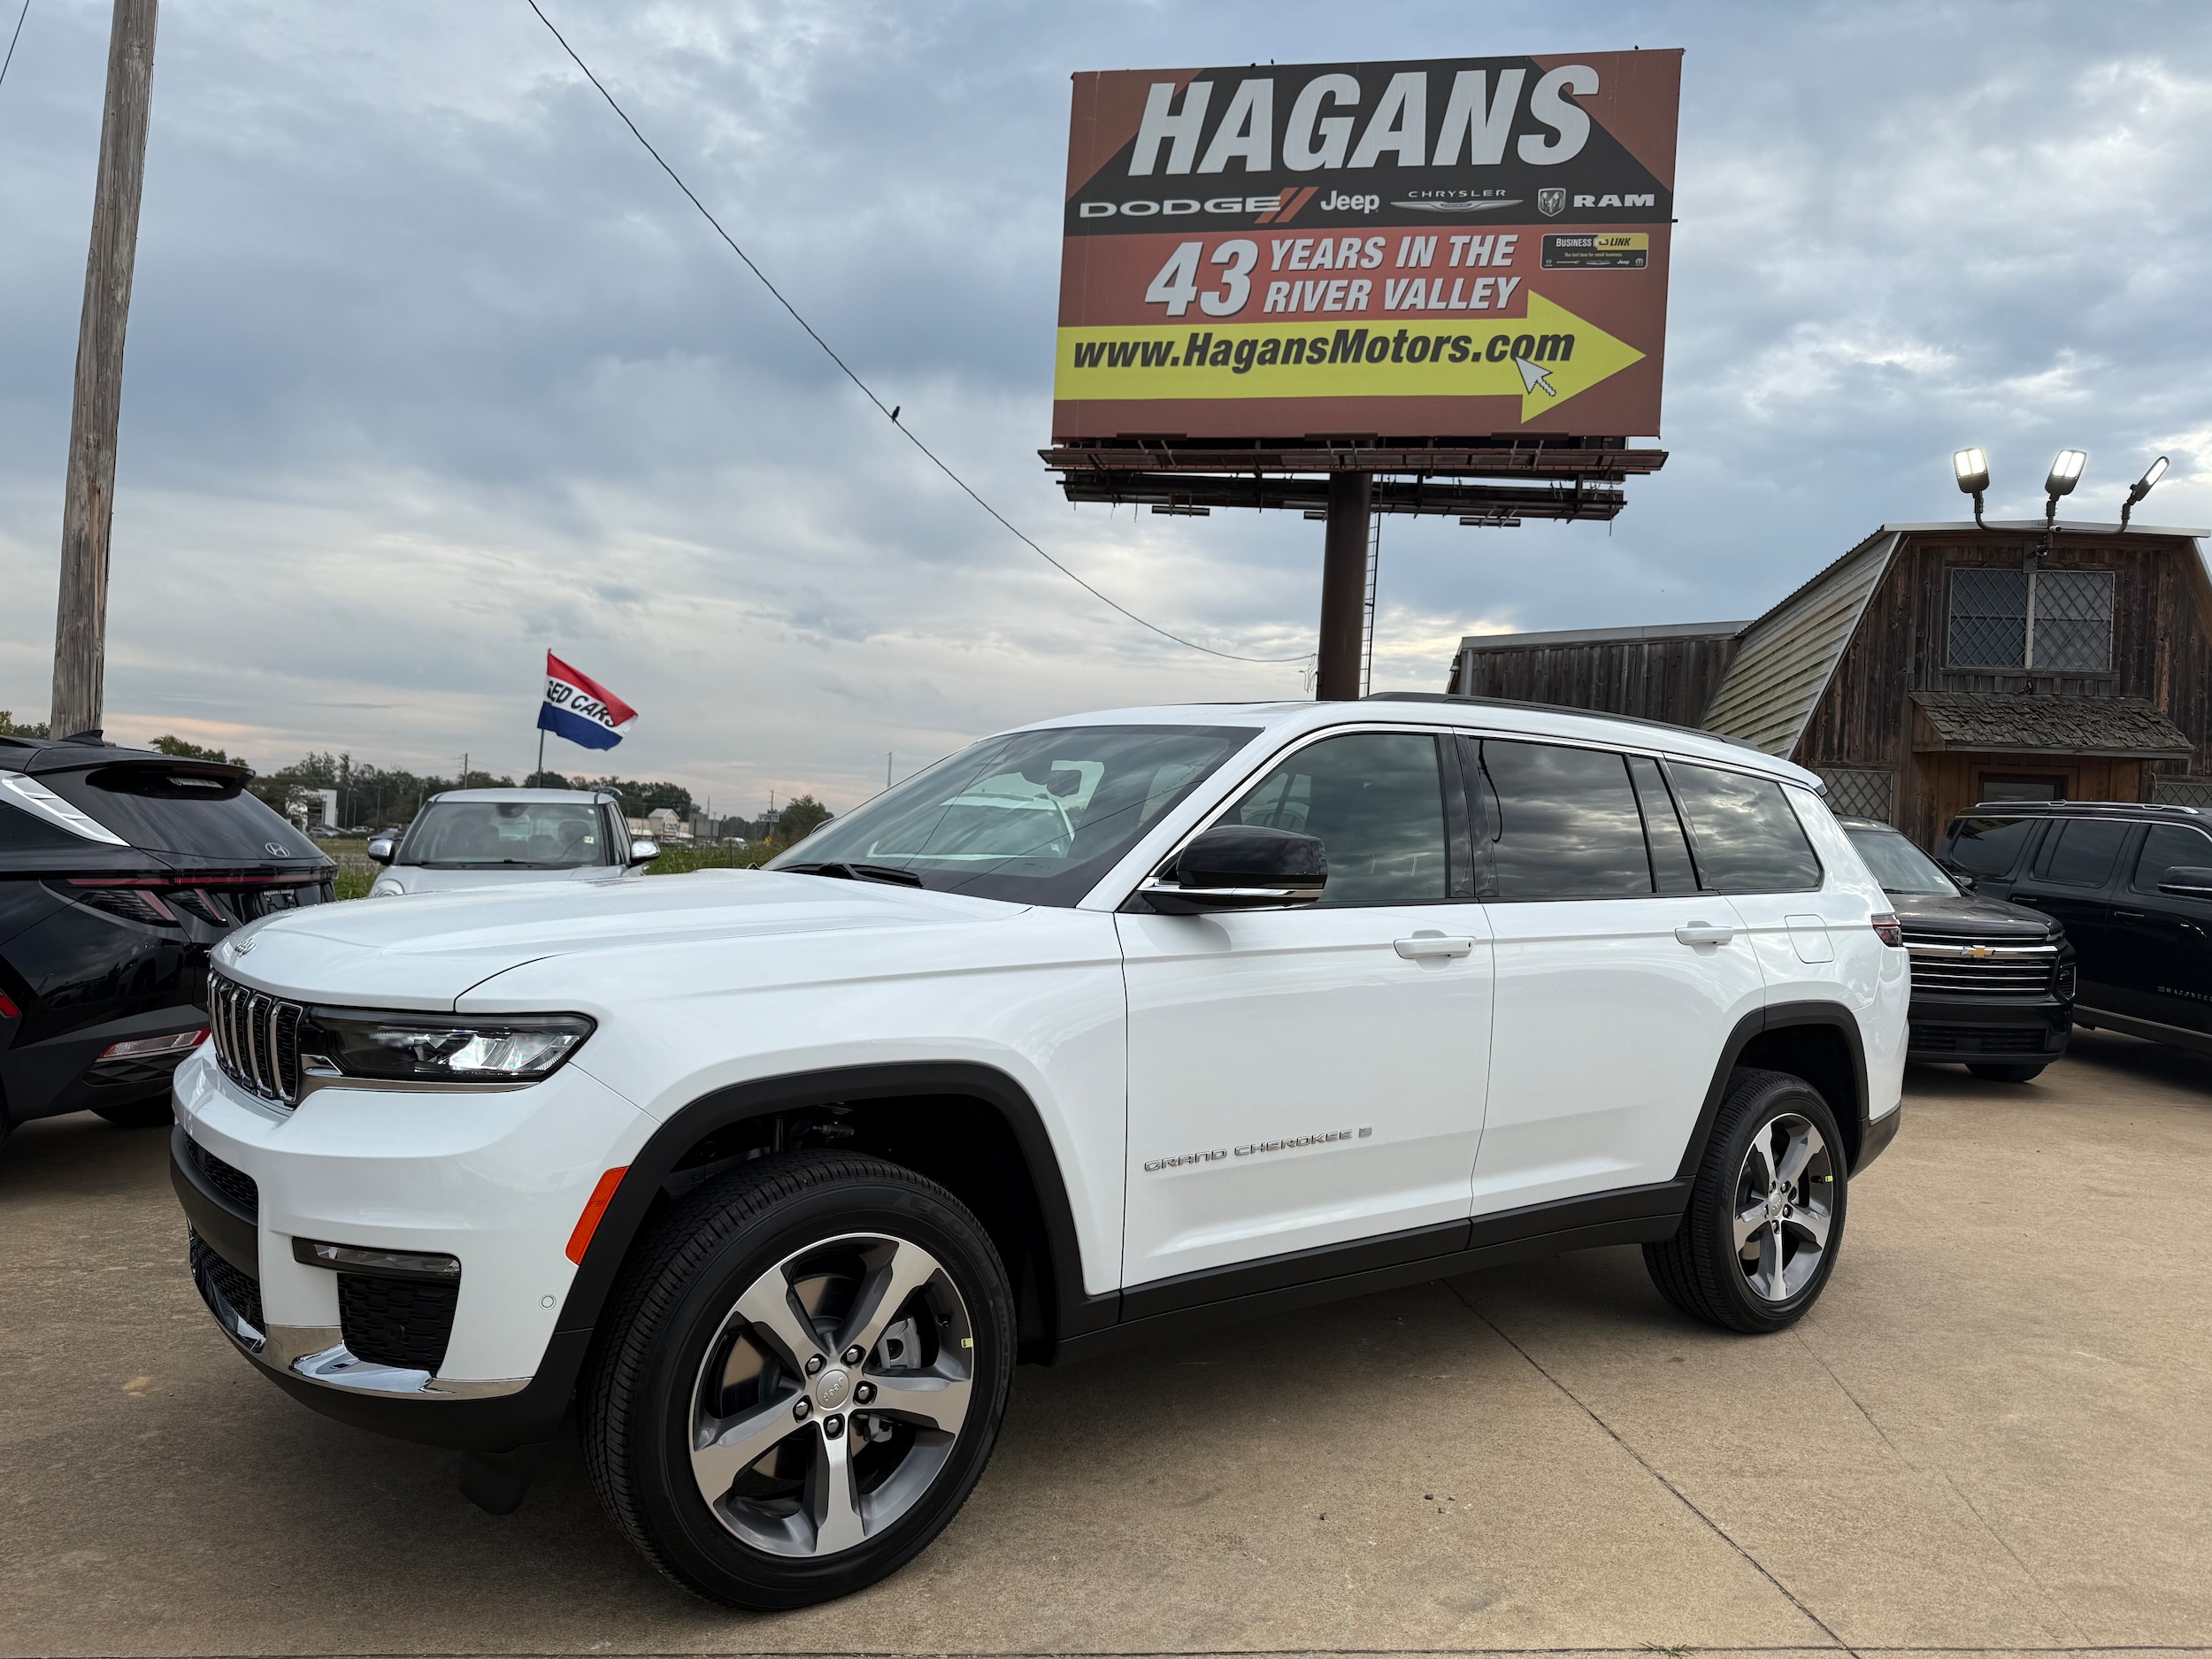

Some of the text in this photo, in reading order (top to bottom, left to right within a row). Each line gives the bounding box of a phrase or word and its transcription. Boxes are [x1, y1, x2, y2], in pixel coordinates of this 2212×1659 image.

[1127, 65, 1600, 176] HAGANS
[1079, 196, 1281, 218] DODGE
[1320, 190, 1379, 213] Jeep
[1408, 189, 1506, 198] CHRYSLER
[1573, 194, 1655, 207] RAM
[1270, 234, 1519, 271] YEARS IN THE
[1555, 237, 1632, 248] BUSINESS LINK
[1144, 240, 1259, 317] 43
[1263, 276, 1522, 314] RIVER VALLEY
[1073, 328, 1575, 374] www.HagansMotors.com
[1144, 1129, 1353, 1171] GRAND CHEROKEE
